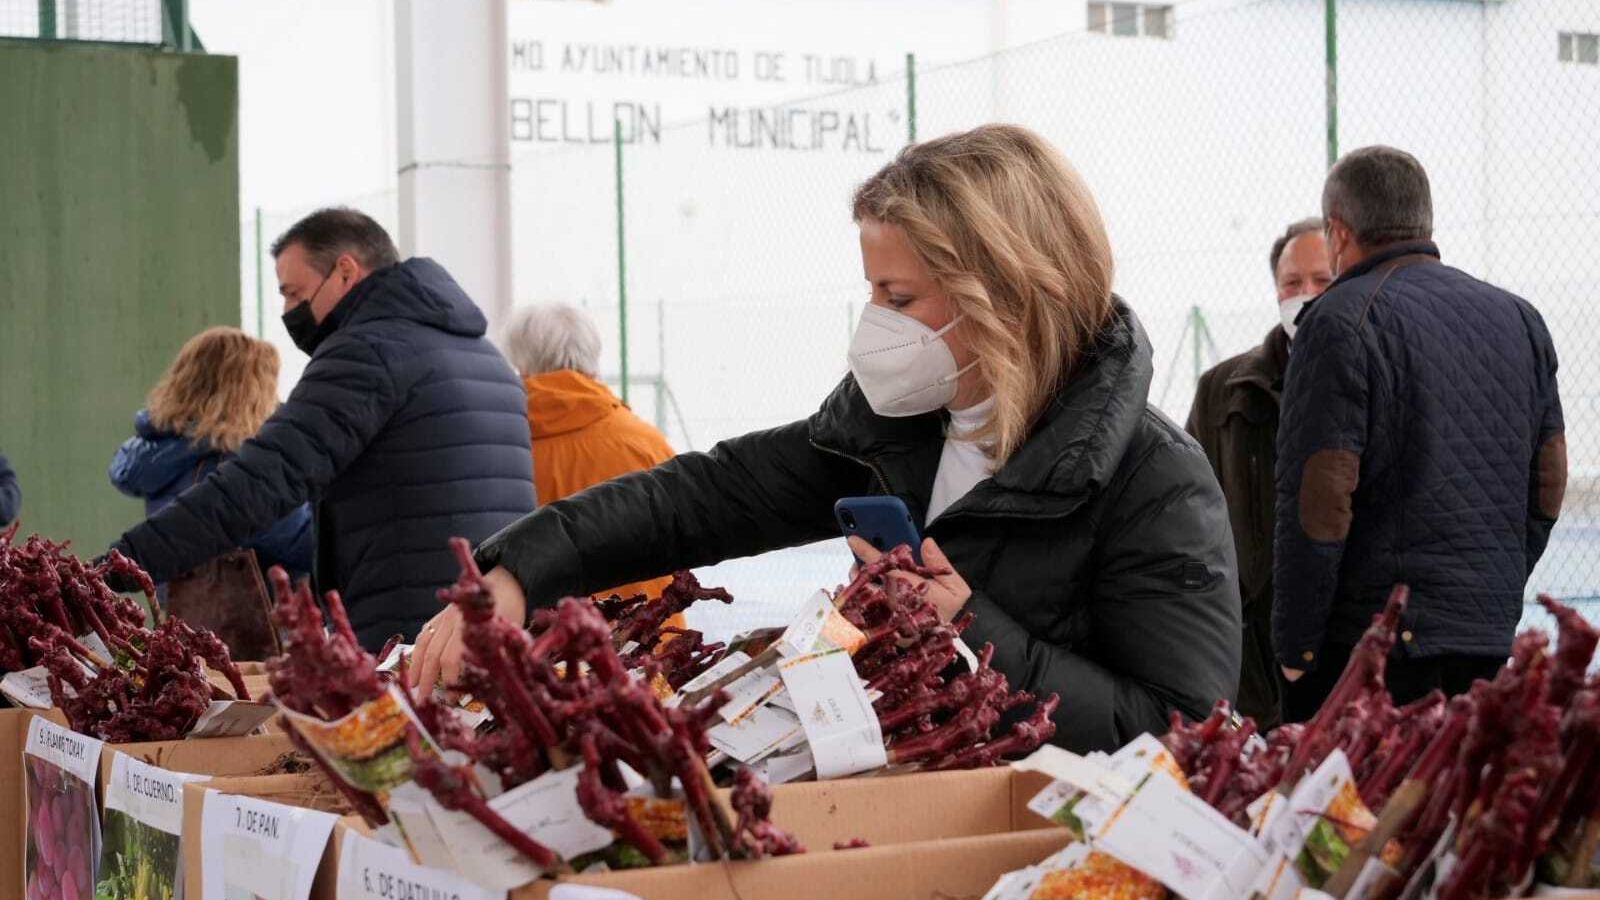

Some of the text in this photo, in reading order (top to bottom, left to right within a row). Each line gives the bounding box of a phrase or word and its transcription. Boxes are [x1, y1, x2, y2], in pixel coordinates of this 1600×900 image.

[560, 42, 738, 80] AYUNTAMIENTO
[754, 52, 786, 82] DE
[803, 54, 879, 87] TIJOLA
[511, 98, 884, 153] BELLON MUNICIPAL
[247, 810, 257, 833] DE
[379, 871, 394, 900] DE
